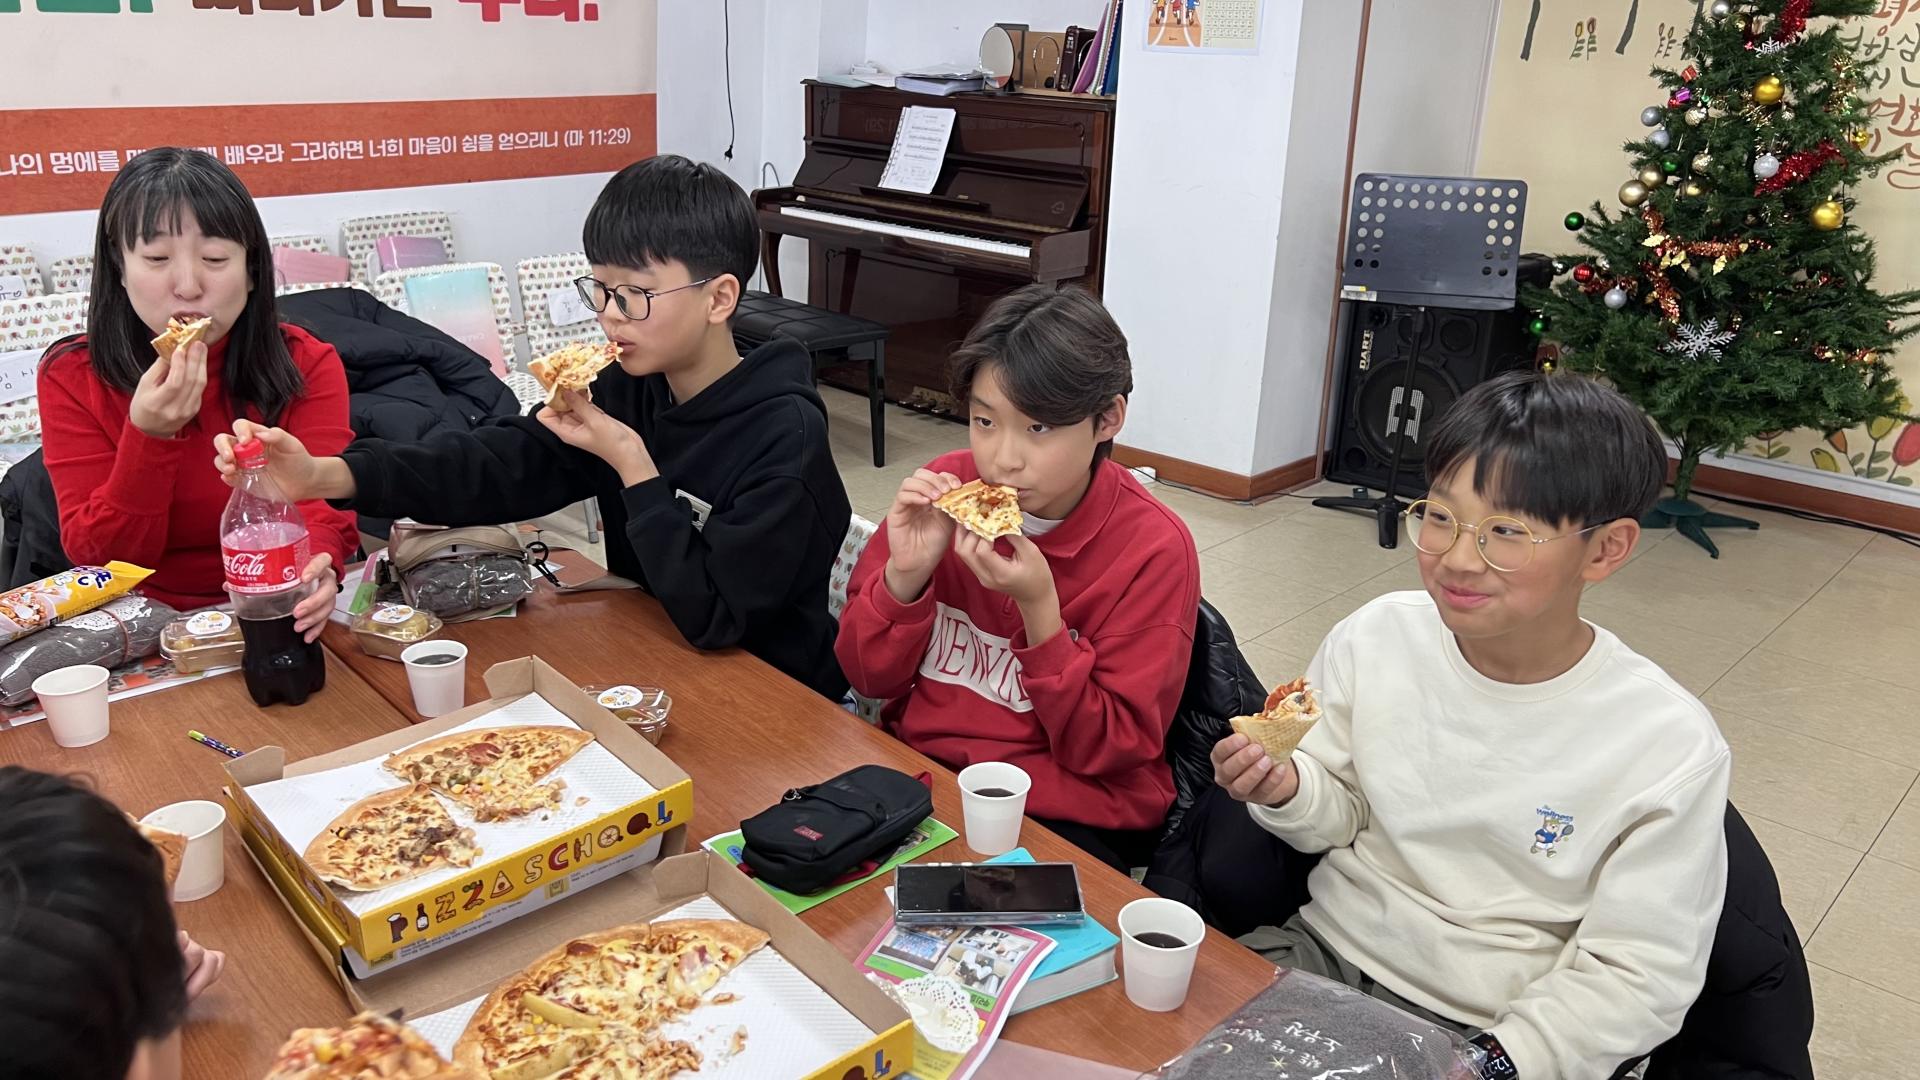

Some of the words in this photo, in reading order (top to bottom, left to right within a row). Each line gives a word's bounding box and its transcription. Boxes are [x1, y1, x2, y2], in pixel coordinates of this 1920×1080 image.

[50, 150, 120, 175] 멍에를
[225, 144, 285, 166] 배우라
[290, 140, 364, 163] 그리하면
[369, 138, 404, 158] 너희
[408, 135, 457, 156] 마음이
[462, 133, 494, 153] 쉼을
[498, 131, 559, 151] 얻으리니
[564, 130, 584, 148] (마
[588, 127, 631, 147] 11:29)
[1359, 329, 1371, 370] DART
[386, 869, 514, 944] PIZZA
[523, 799, 674, 885] SCHOOL
